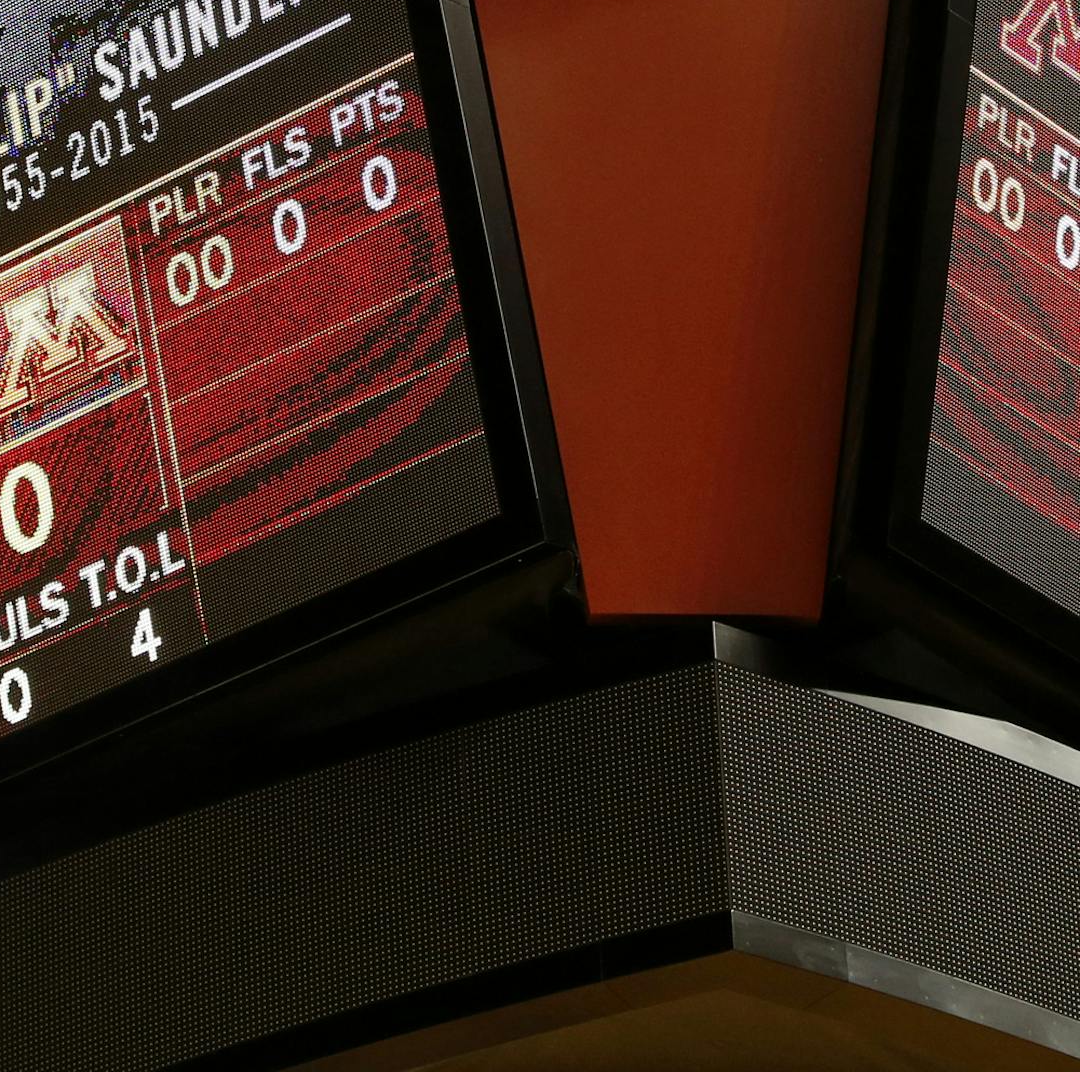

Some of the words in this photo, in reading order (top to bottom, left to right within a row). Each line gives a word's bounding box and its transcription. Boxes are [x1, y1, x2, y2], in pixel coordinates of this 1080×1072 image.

[147, 170, 223, 236] PLR
[241, 126, 313, 191] FLS
[329, 79, 406, 148] PTS
[977, 94, 1038, 164] PLR
[166, 234, 235, 308] 00
[273, 198, 308, 256] 0
[361, 154, 398, 212] 0
[973, 158, 1026, 232] 00
[0, 460, 55, 554] 0
[77, 529, 186, 610] T.O.L
[130, 607, 163, 663] 4
